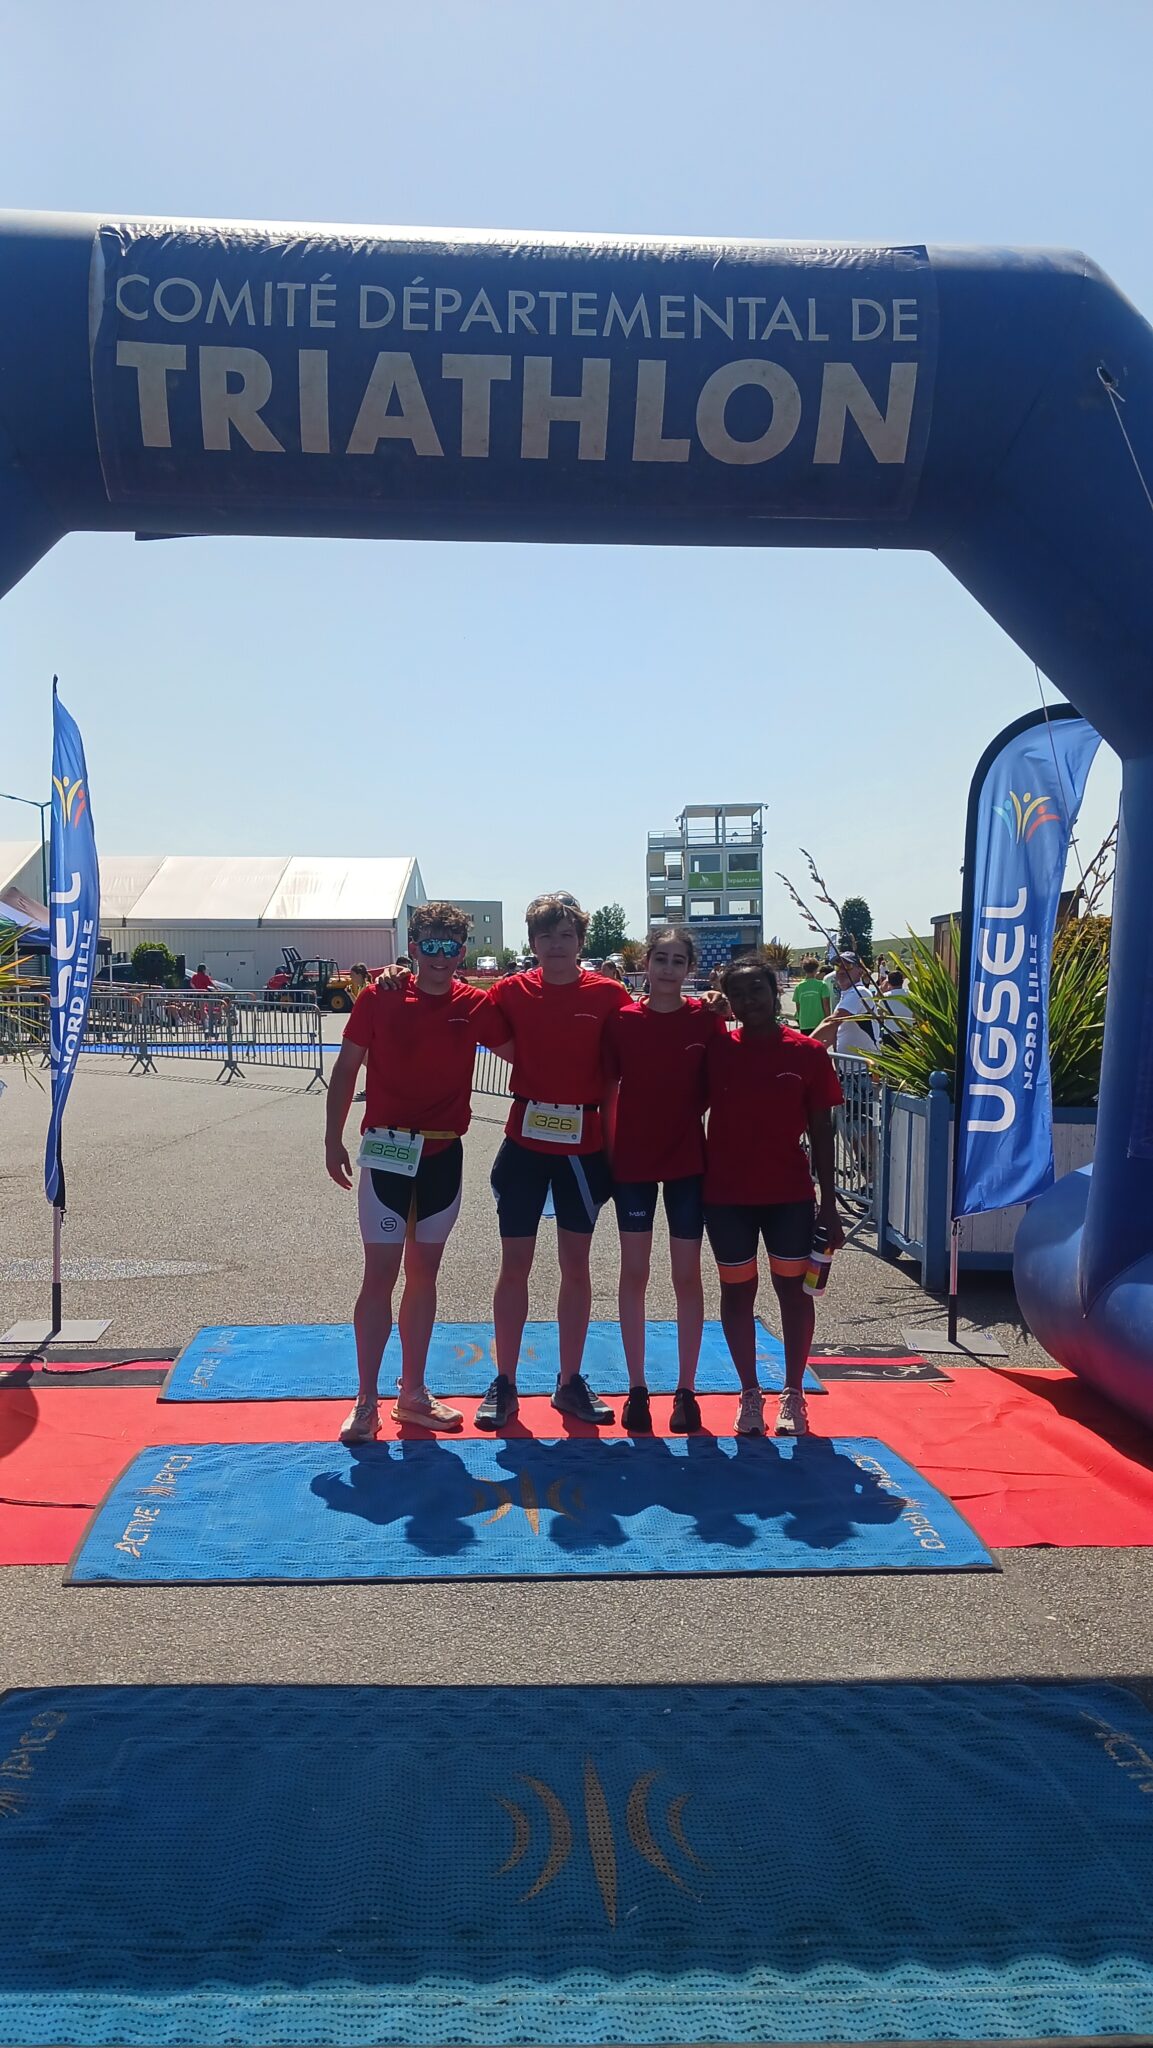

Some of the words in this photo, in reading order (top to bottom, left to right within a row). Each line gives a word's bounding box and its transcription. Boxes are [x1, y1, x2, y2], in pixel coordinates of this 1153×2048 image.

[116, 272, 337, 328] COMITÉ
[359, 276, 829, 342] DÉPARTEMENTAL
[851, 298, 918, 342] DE
[116, 340, 918, 465] TRIATHLON
[61, 996, 85, 1075] NORD
[73, 919, 94, 988] LILLE
[1027, 934, 1040, 1003] LILLE
[967, 887, 1028, 1132] UGSEL
[1023, 1011, 1039, 1090] NORD
[370, 1142, 410, 1160] 326
[535, 1114, 572, 1130] 326
[113, 1505, 161, 1558] ACTIVE
[901, 1511, 946, 1549] IPICO
